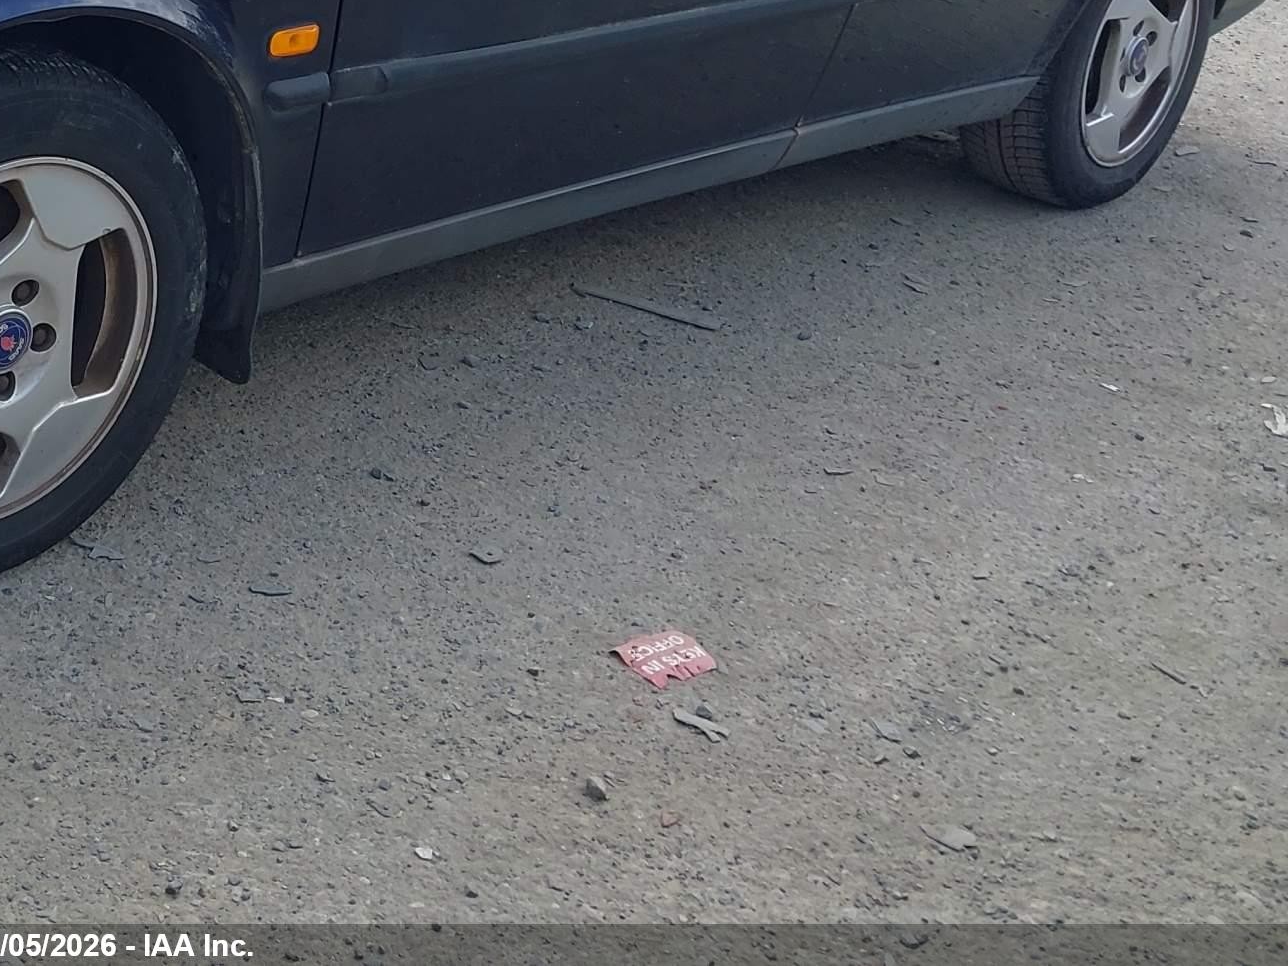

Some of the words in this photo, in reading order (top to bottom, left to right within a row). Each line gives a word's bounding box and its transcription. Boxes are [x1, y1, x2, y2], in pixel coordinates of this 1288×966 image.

[627, 635, 685, 662] OFFICE
[662, 645, 706, 667] KEYS
[641, 659, 665, 675] IN
